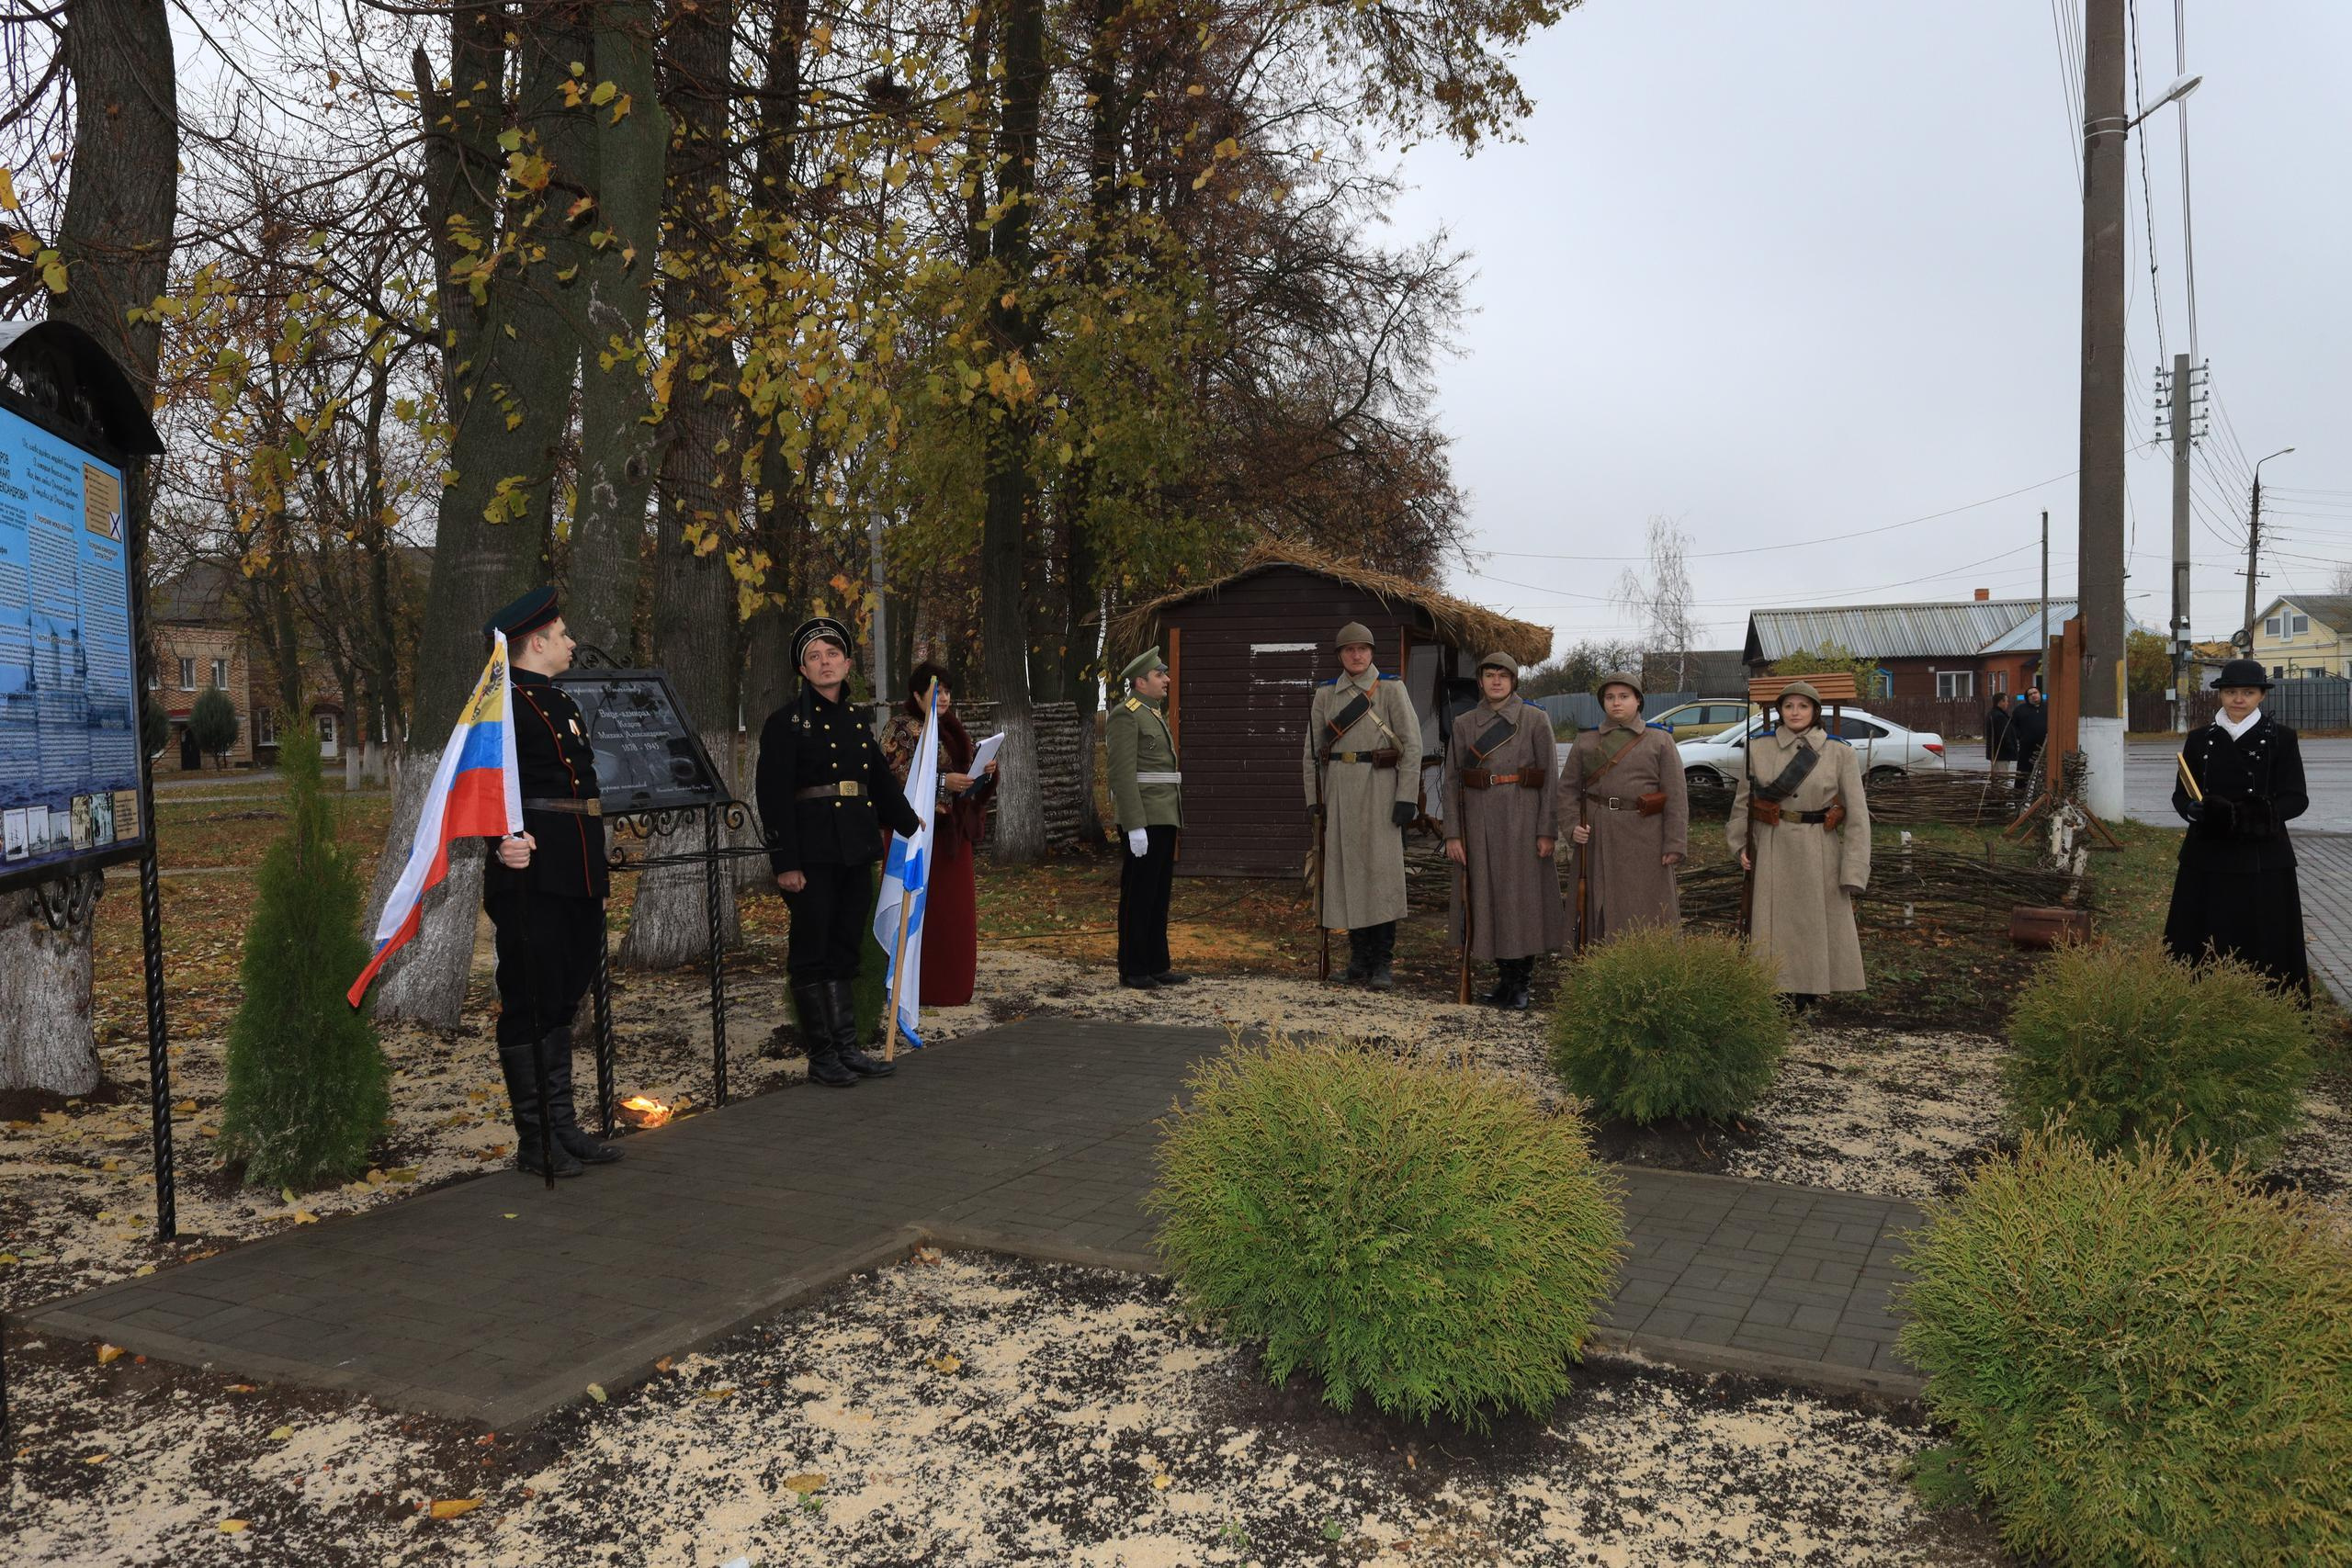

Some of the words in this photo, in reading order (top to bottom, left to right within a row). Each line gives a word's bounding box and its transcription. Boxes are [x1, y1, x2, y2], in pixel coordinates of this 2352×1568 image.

[597, 708, 652, 720] Вице-адмирал
[617, 719, 642, 728] Кедров
[597, 731, 625, 739] Михаил
[625, 730, 671, 739] Александрович
[644, 741, 661, 751] 1945
